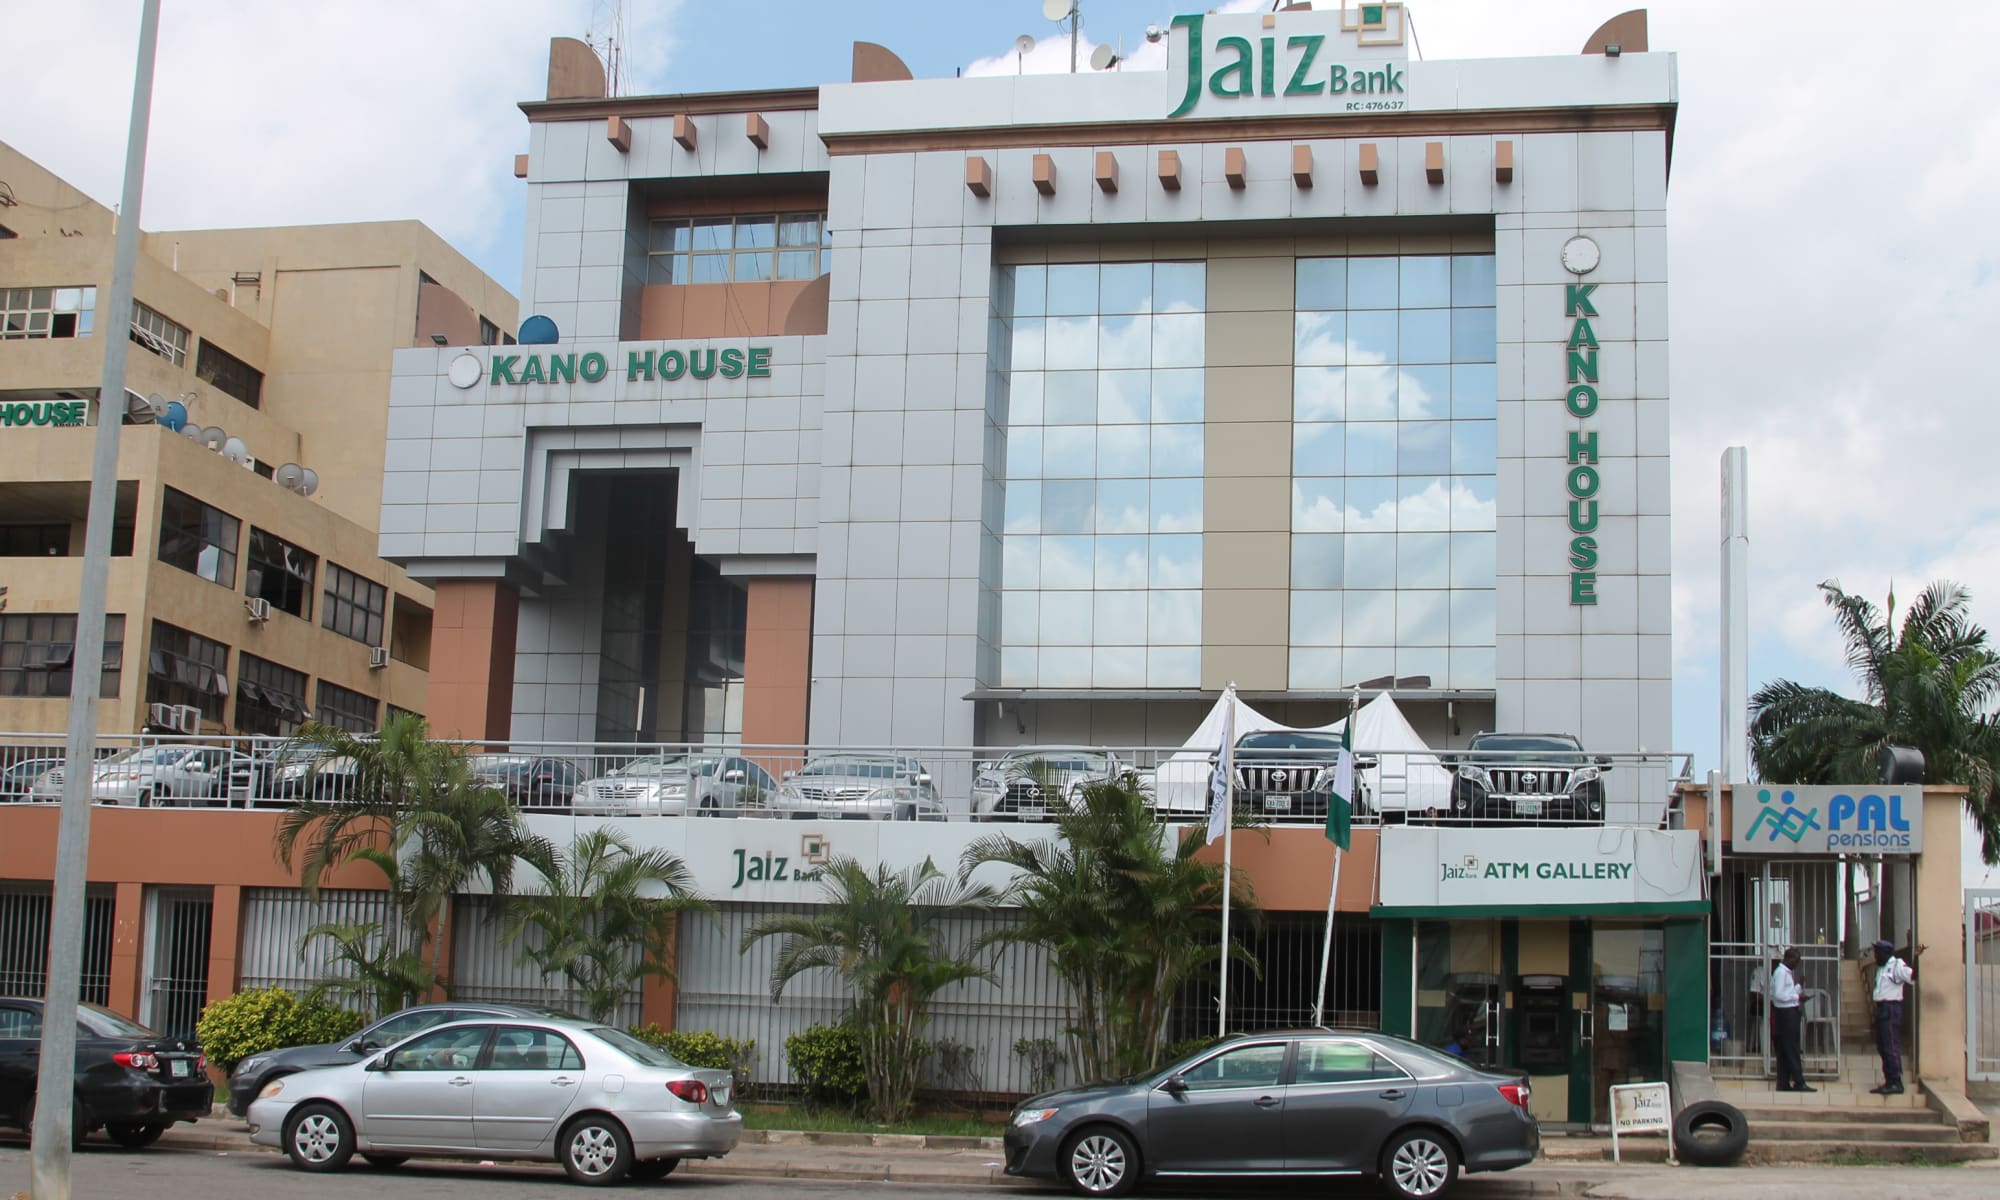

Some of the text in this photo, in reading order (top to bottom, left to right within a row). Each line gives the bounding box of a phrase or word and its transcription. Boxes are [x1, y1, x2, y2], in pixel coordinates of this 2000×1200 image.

[1167, 14, 1404, 118] Jaiz Bank
[1346, 101, 1404, 111] RC:476637
[490, 346, 772, 385] KANO HOUSE
[1565, 283, 1600, 606] KANO HOUSE
[1828, 794, 1910, 832] PAL
[1827, 833, 1911, 850] pensions
[732, 848, 789, 888] Jaiz
[1440, 863, 1465, 881] Jaiz
[1484, 862, 1529, 879] ATM
[1536, 862, 1633, 879] GALLERY
